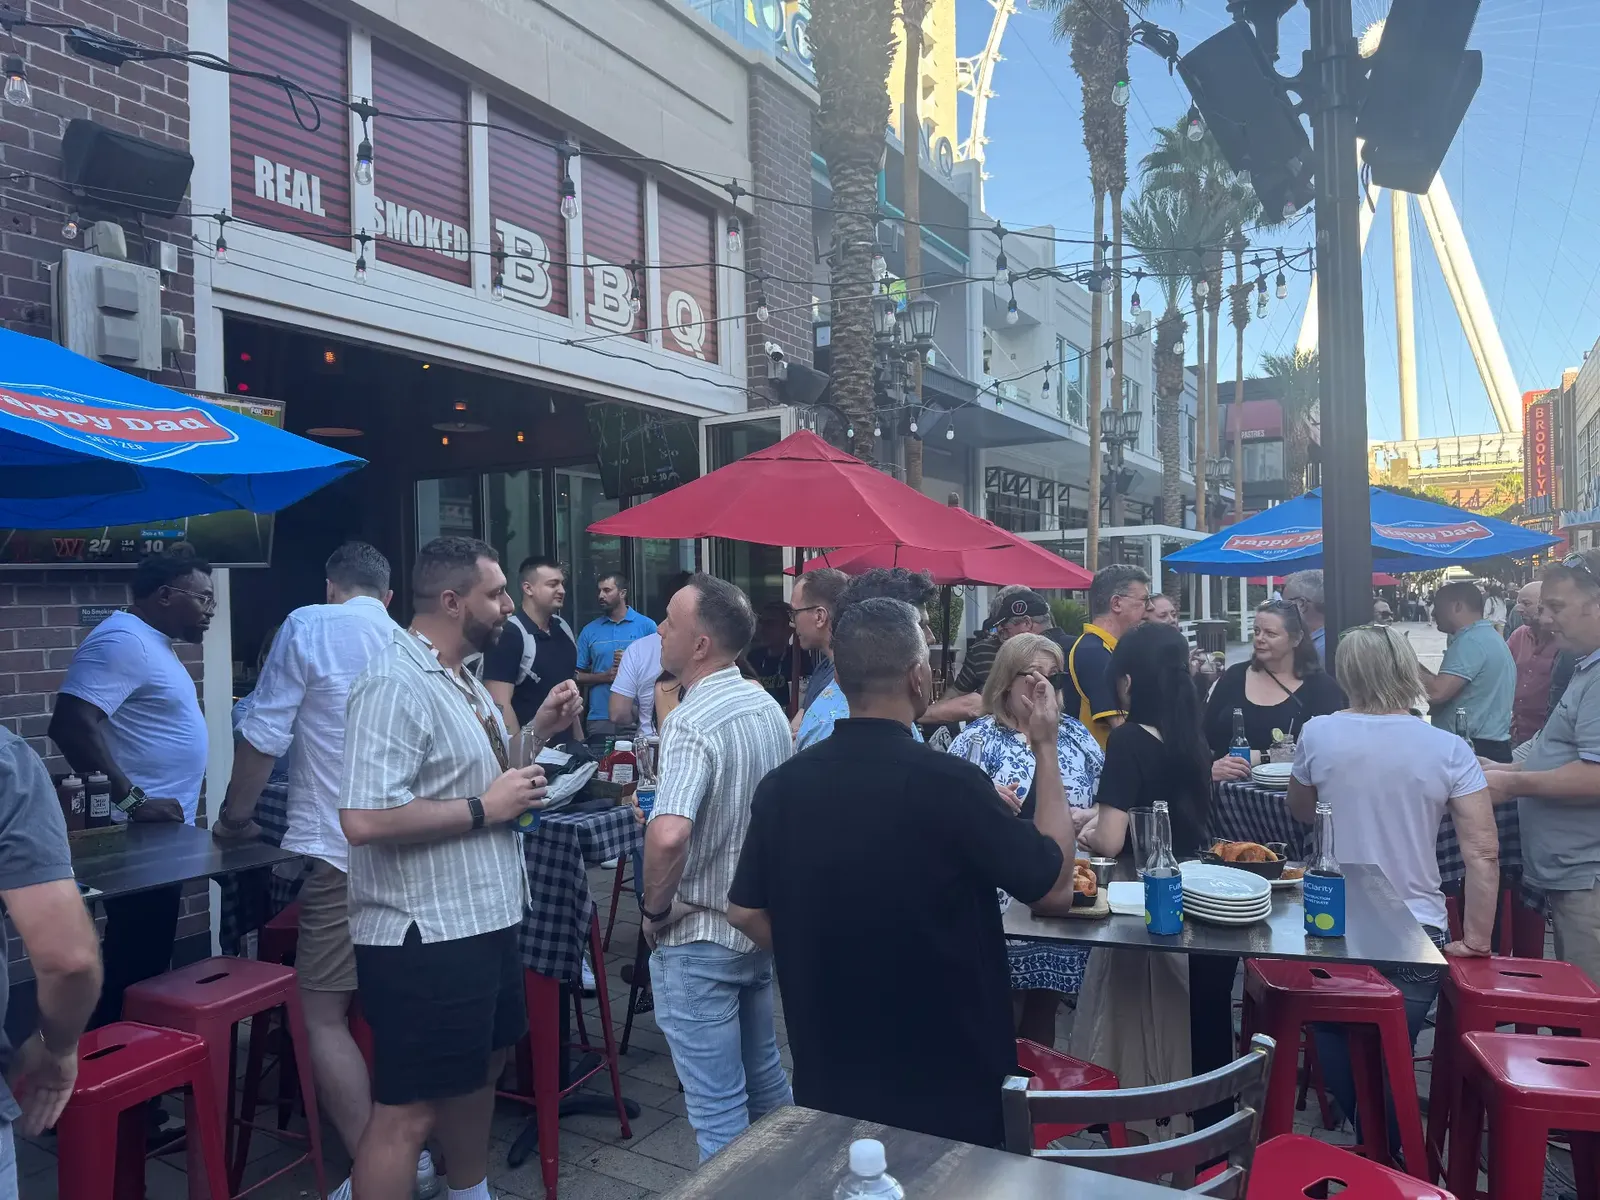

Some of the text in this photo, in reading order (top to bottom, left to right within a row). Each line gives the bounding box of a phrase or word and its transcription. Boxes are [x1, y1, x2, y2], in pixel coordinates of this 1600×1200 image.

[254, 155, 325, 217] REAL
[373, 195, 469, 262] SMOKED
[0, 394, 210, 431] appy Dad
[85, 434, 147, 451] SELTZER
[1297, 533, 1323, 544] Da
[1438, 526, 1480, 538] Dad
[88, 539, 110, 552] 27
[144, 540, 163, 552] 10
